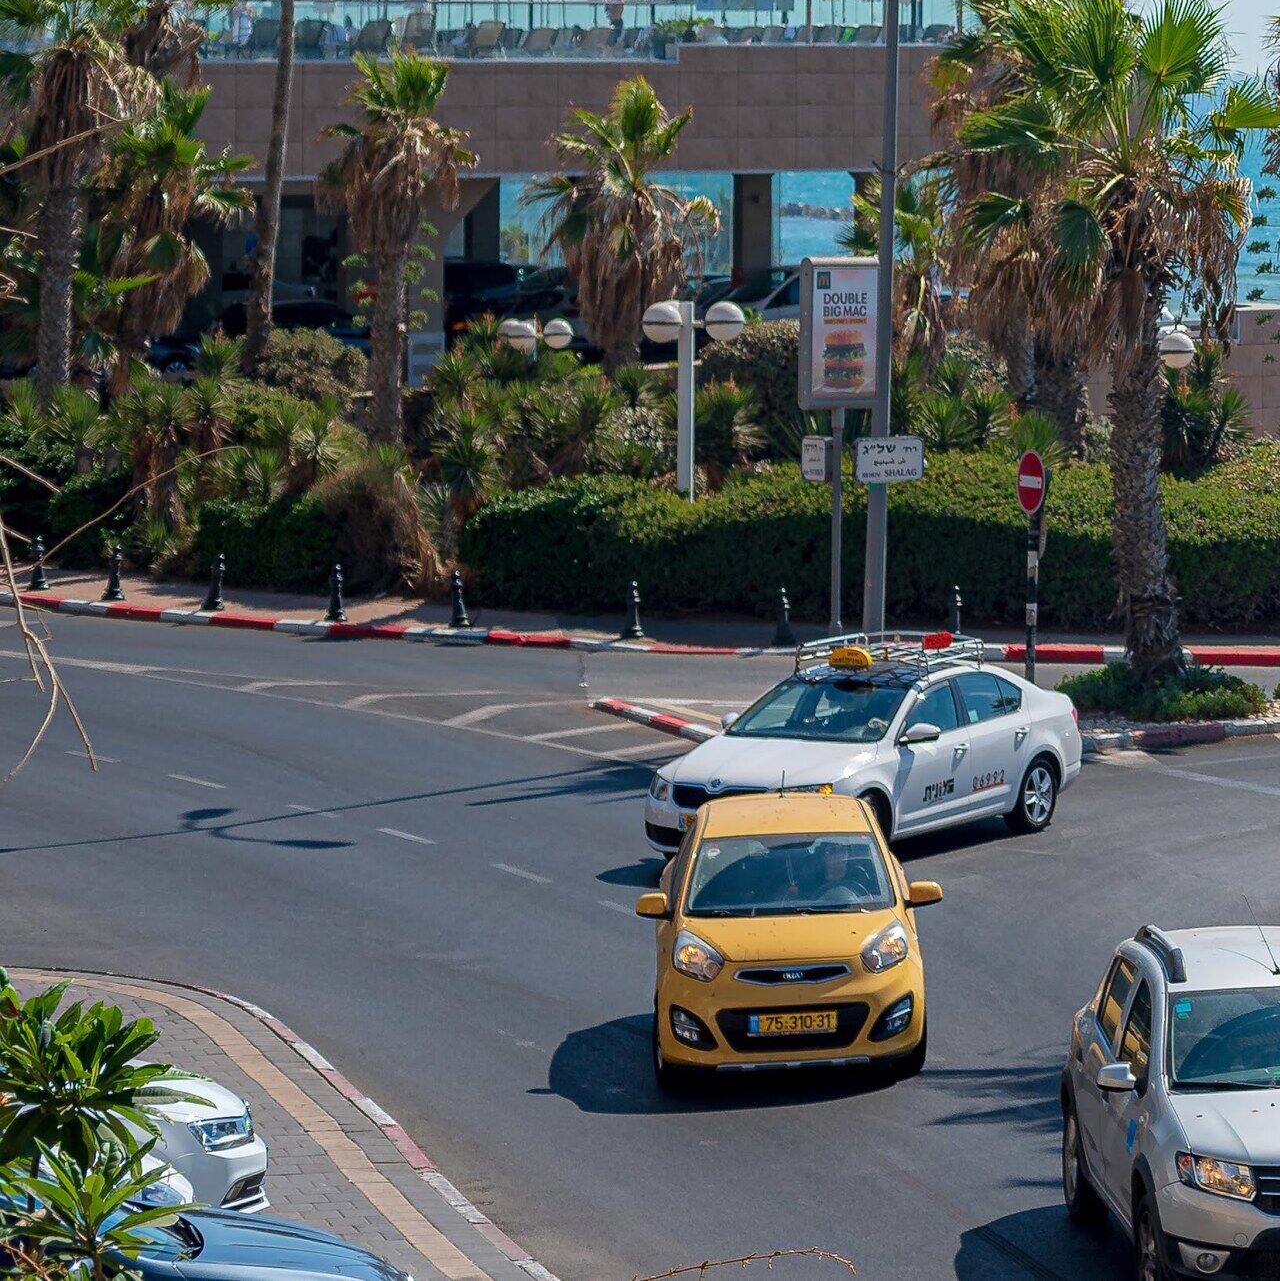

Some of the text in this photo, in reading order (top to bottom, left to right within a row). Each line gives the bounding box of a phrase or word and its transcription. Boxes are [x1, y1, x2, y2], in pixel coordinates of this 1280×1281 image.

[823, 292, 868, 305] DOUBLE
[823, 305, 867, 317] BIG MAC
[884, 468, 917, 478] SHALAG
